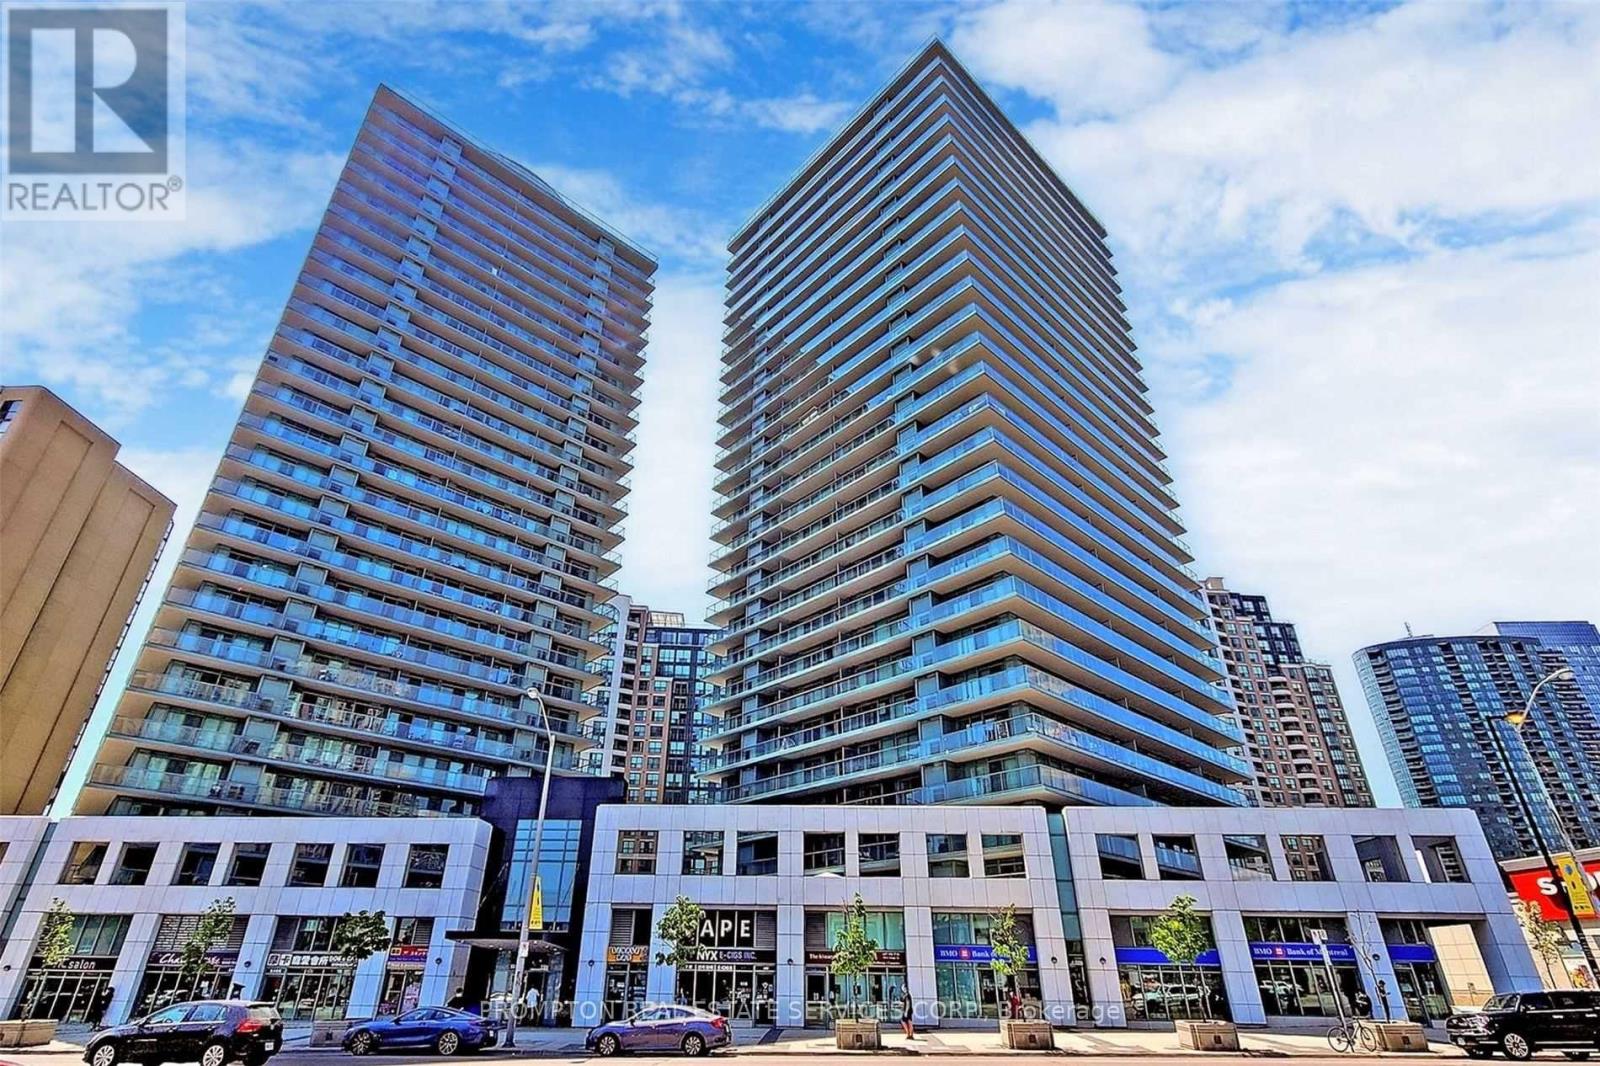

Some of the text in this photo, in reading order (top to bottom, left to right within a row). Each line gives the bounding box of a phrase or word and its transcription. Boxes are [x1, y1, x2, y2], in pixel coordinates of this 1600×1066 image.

[697, 950, 718, 961] NYX
[972, 950, 990, 958] Bank
[1253, 947, 1273, 955] BMO
[1286, 948, 1306, 956] Bank
[68, 959, 96, 969] salon
